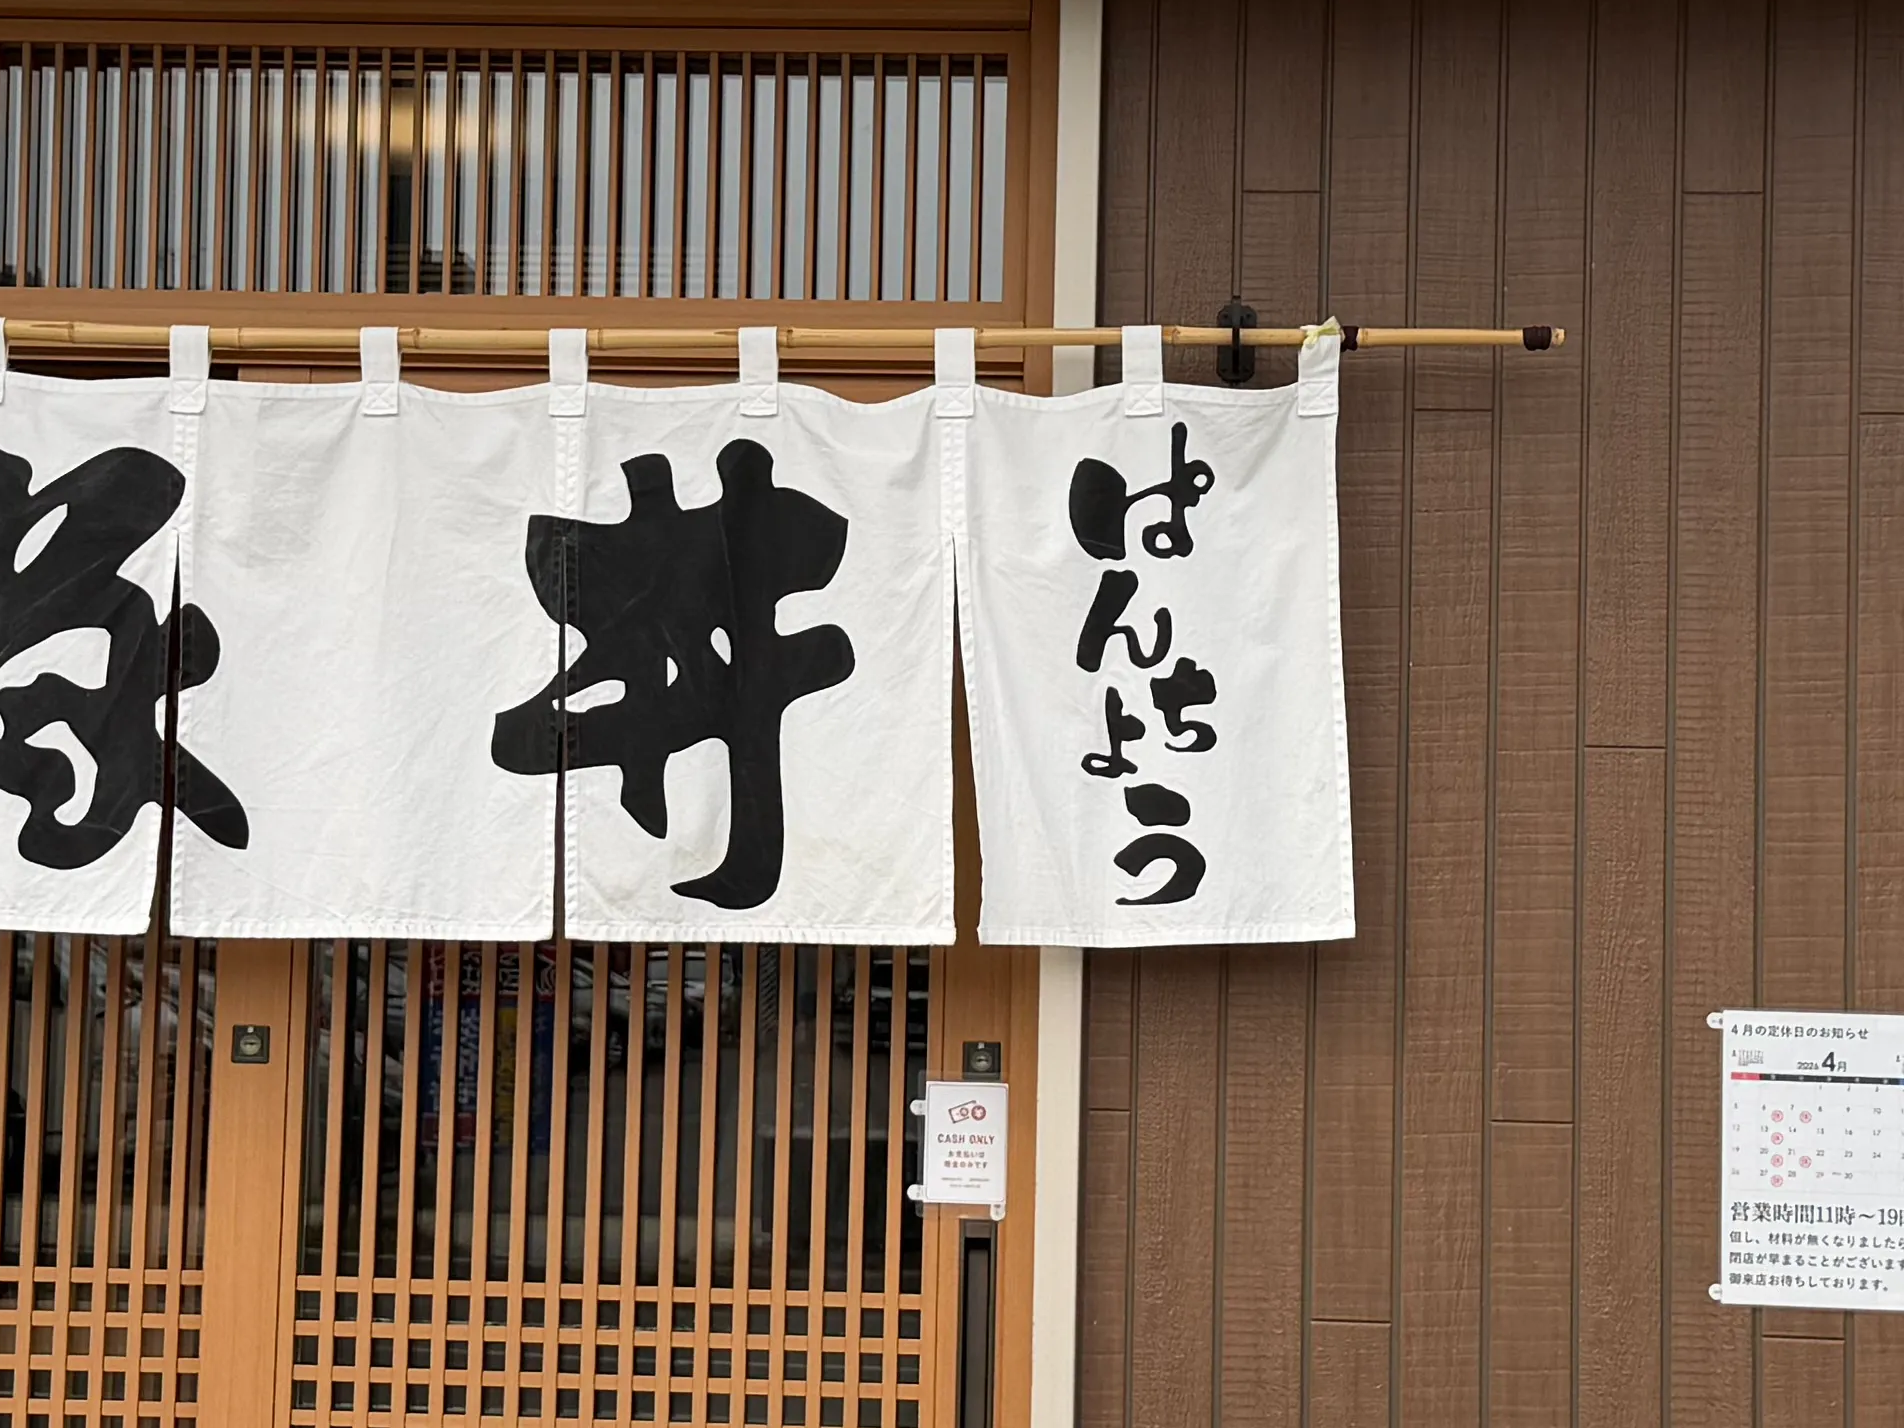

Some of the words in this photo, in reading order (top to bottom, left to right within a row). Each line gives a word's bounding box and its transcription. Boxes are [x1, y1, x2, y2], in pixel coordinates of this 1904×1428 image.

[1068, 421, 1218, 907] ぱんちょう
[1731, 1024, 1869, 1039] 4月の定休日のお知らせ
[938, 1134, 965, 1143] CASH
[969, 1134, 995, 1145] ONLY
